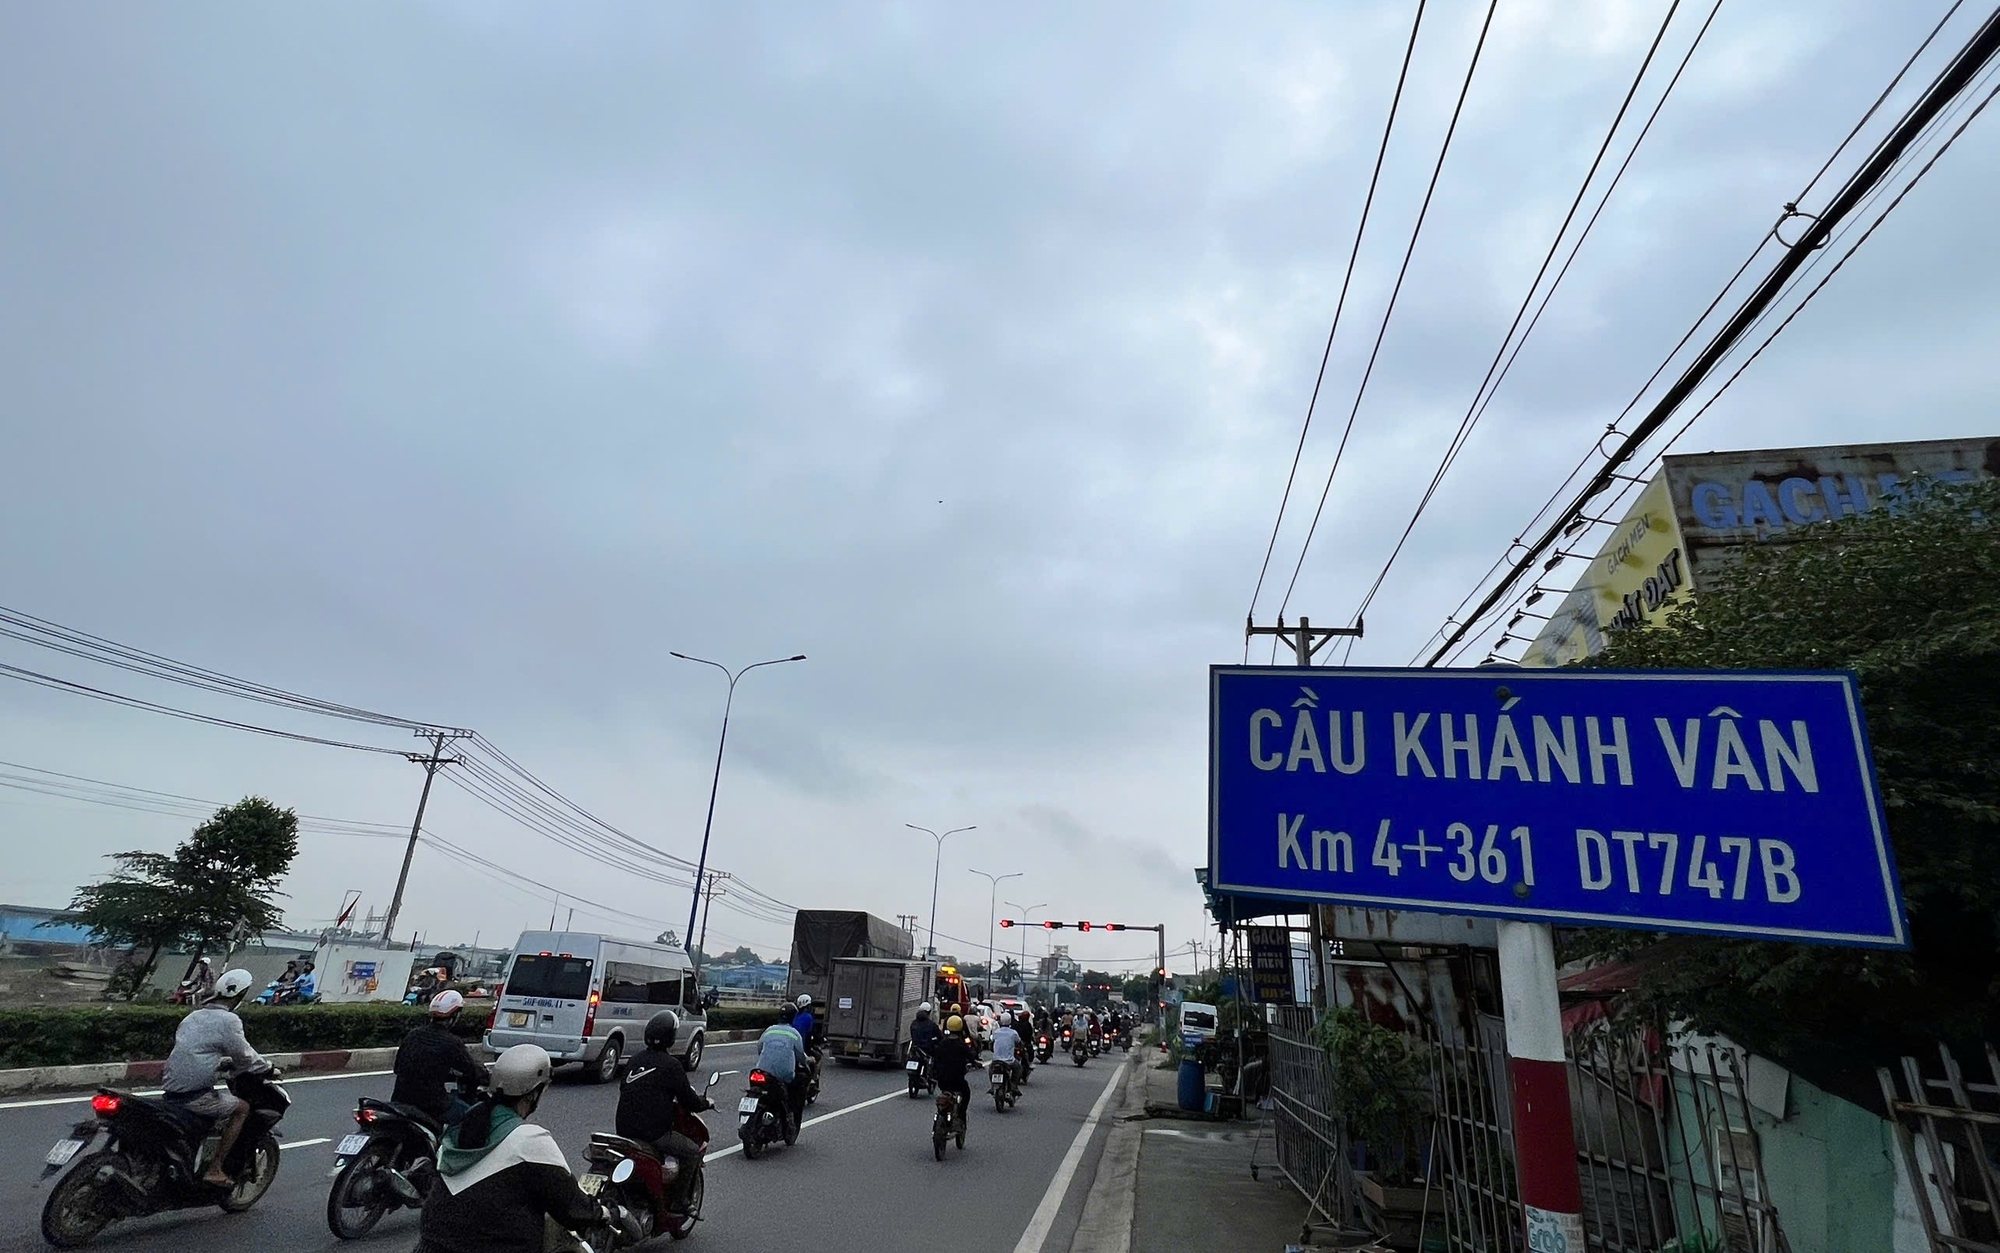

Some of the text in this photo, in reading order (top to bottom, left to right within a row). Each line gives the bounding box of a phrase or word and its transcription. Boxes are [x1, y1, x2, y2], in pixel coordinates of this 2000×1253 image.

[1249, 686, 1819, 792] CẦU KHÁNH VÂN
[1277, 813, 1801, 903] Km 4+361 DT747B
[1257, 951, 1284, 969] MEN
